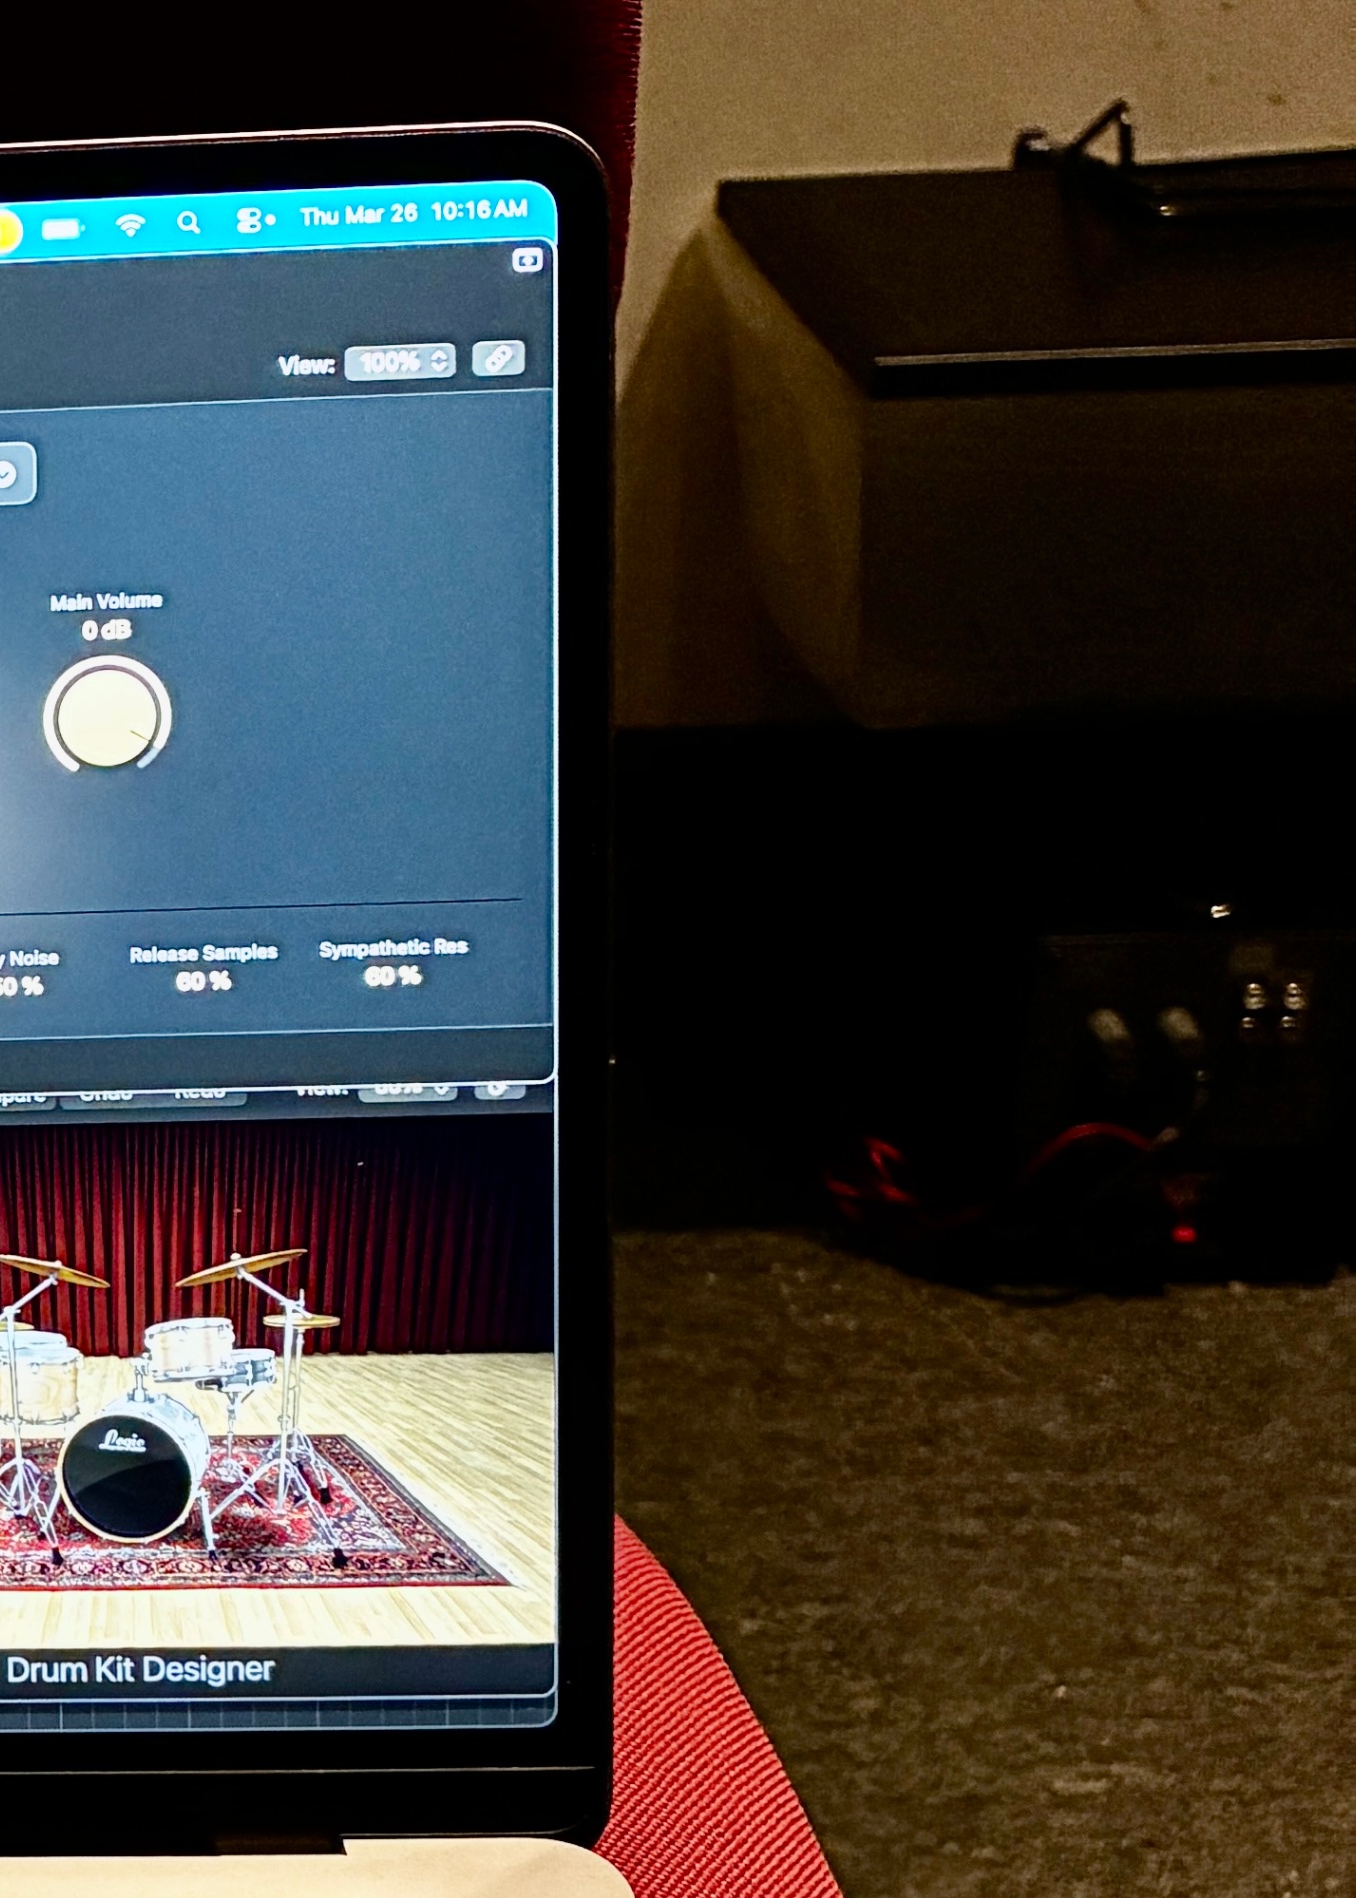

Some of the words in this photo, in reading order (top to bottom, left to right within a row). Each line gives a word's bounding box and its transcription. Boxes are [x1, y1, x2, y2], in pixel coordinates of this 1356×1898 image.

[300, 207, 339, 227] Thu
[345, 205, 386, 225] Mar
[390, 203, 418, 223] 26
[432, 200, 491, 221] 10:16
[493, 198, 529, 218] AM
[278, 354, 336, 376] View:
[360, 350, 420, 373] 100%
[50, 593, 93, 612] Main
[96, 592, 163, 610] Volume
[81, 619, 99, 641] 0
[101, 618, 133, 640] dB
[9, 949, 59, 967] Noise
[129, 945, 199, 964] Release
[202, 942, 279, 964] Samples
[319, 938, 430, 961] Sympathetic
[434, 937, 469, 955] Res
[7, 1656, 88, 1684] Drum
[95, 1654, 135, 1683] Kit
[144, 1654, 276, 1687] Designer
